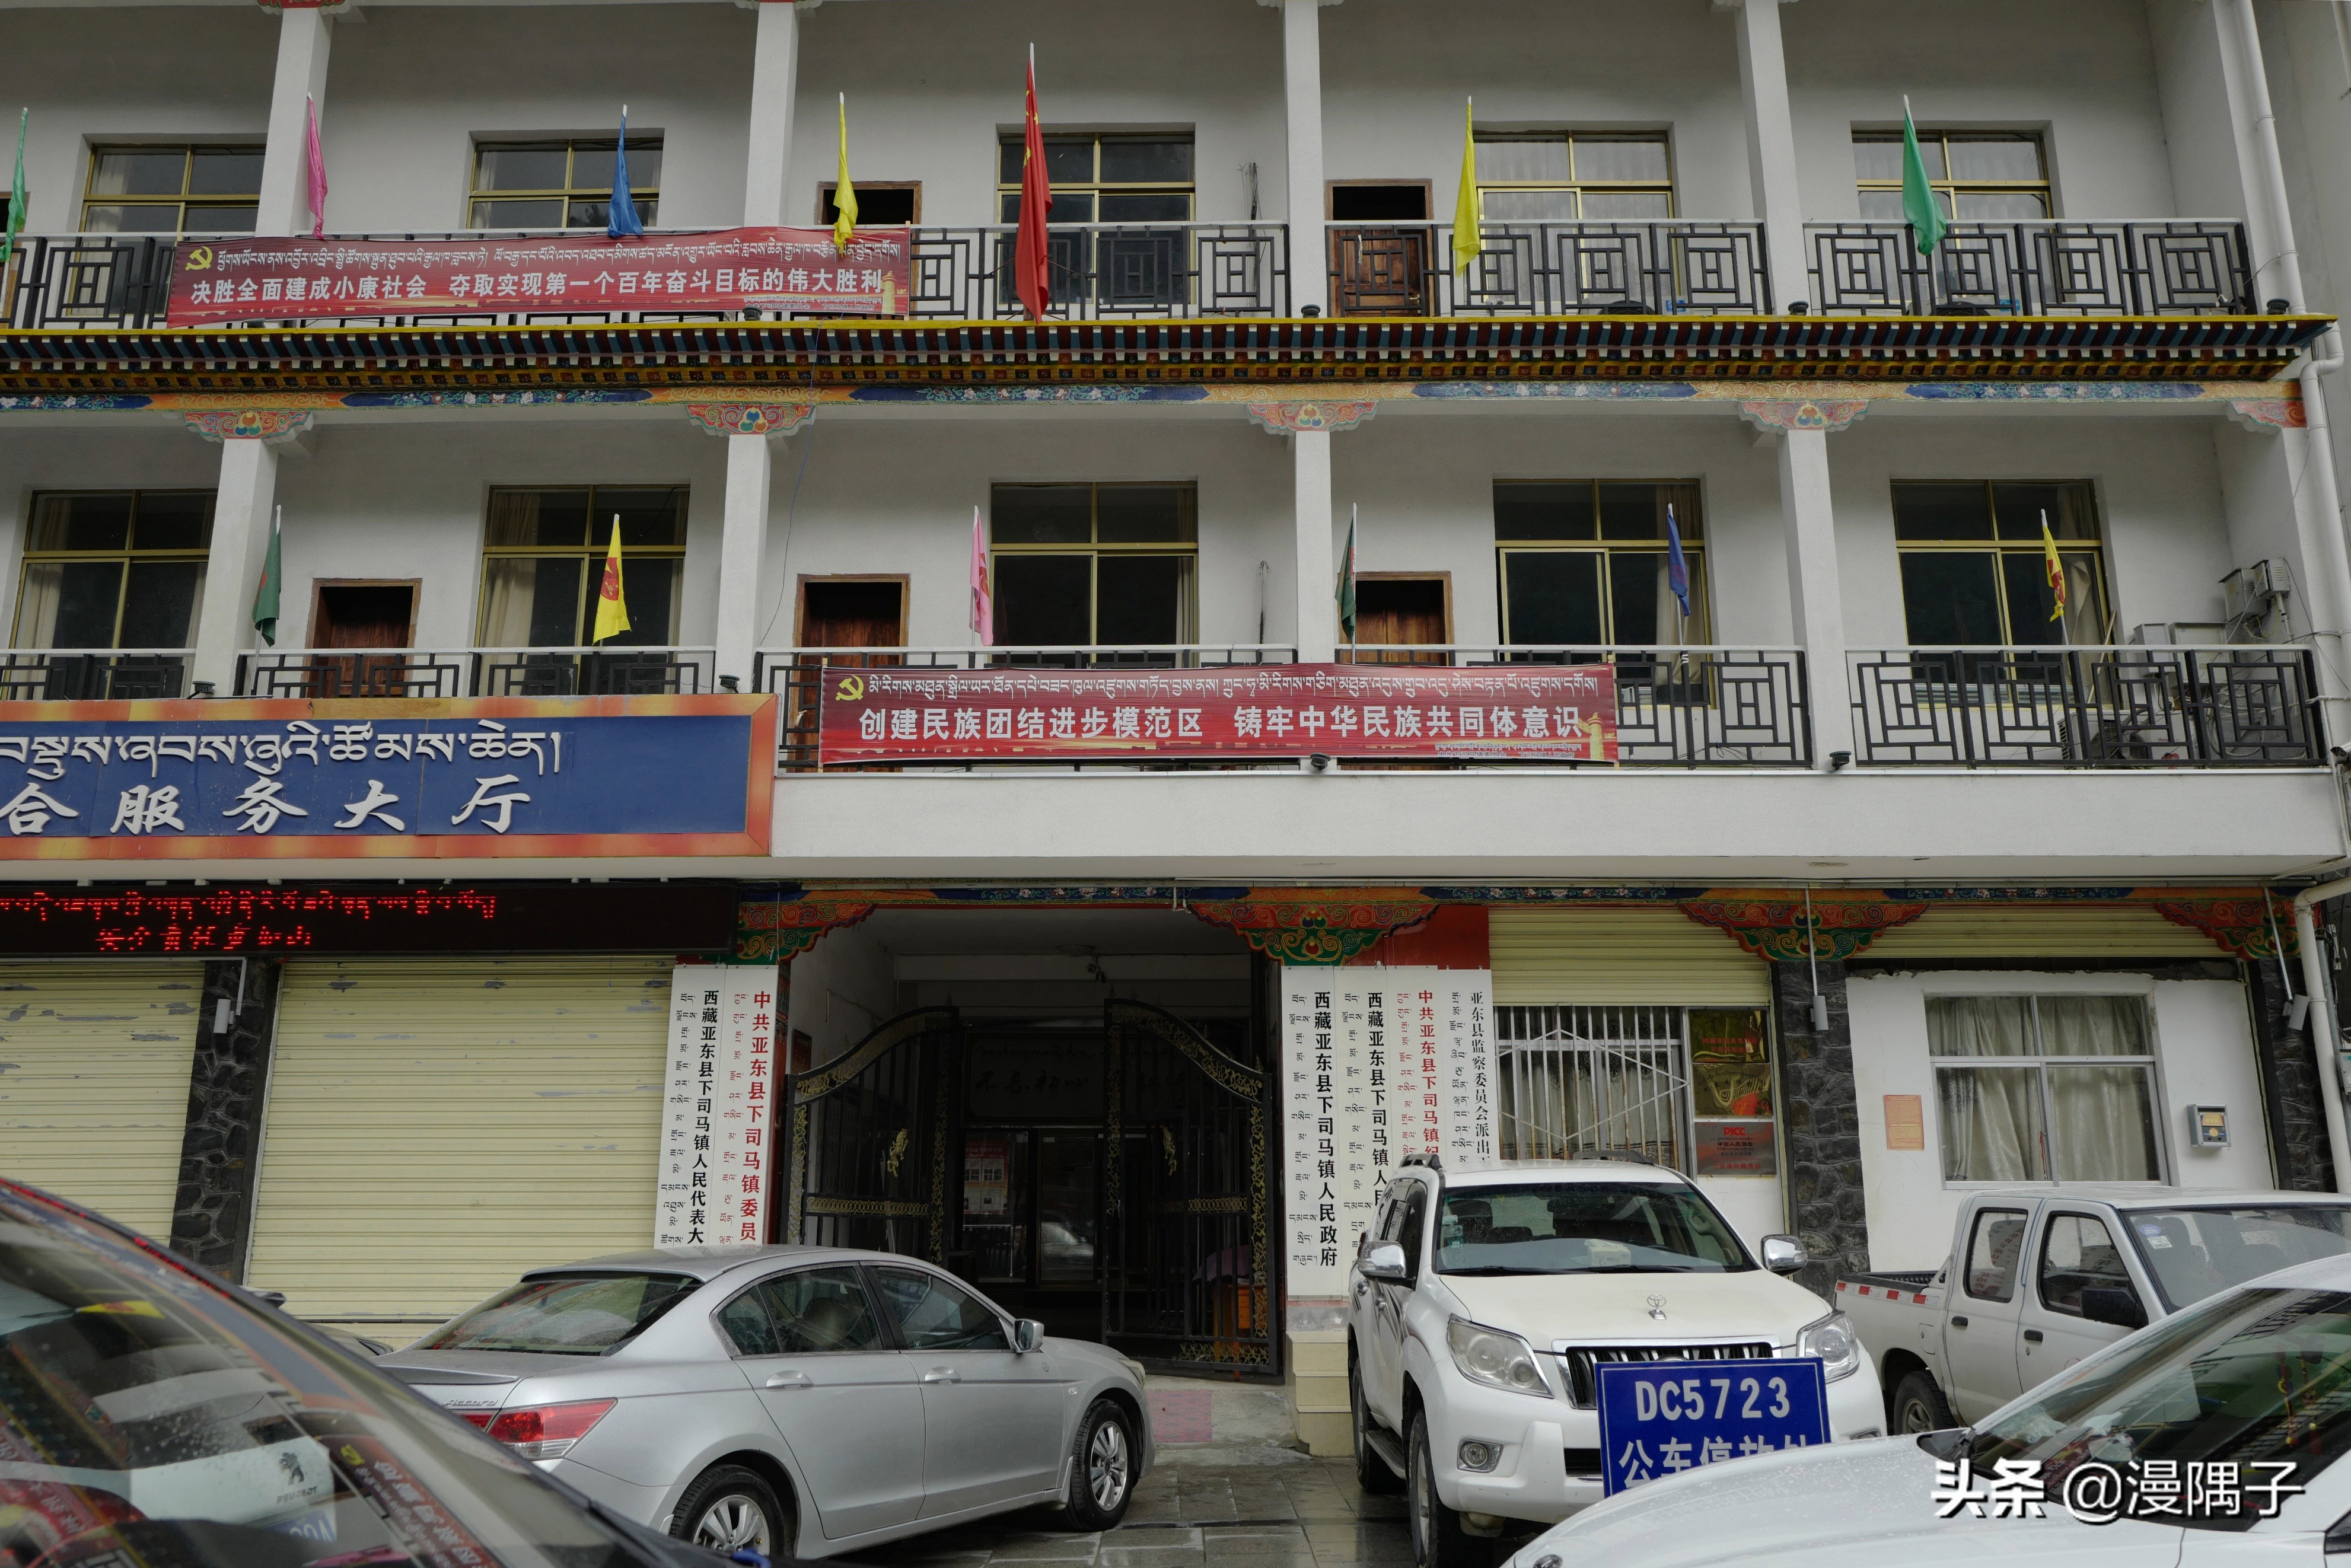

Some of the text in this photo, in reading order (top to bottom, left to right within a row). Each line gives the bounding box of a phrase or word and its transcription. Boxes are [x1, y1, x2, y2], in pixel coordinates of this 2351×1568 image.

[191, 267, 883, 304] 决胜全面建成小康社会 夺取实现第一个百年奋斗目标的伟大胜利
[859, 705, 1583, 741] 创建民族团结进步模范区 铸牢中华民族共同体意识
[0, 774, 531, 834] 合服务大厅
[1469, 991, 1490, 1161] 亚东县监察委员会派出
[687, 990, 719, 1244] 西藏亚东县下司马镇人民代表大
[740, 990, 771, 1241] 中共亚东县下司马镇委员
[1314, 990, 1338, 1267] 西藏亚东县下司马镇人民政府
[1723, 1127, 1747, 1136] PICC
[1635, 1376, 1791, 1422] DC5723
[1619, 1434, 1807, 1488] 公车停
